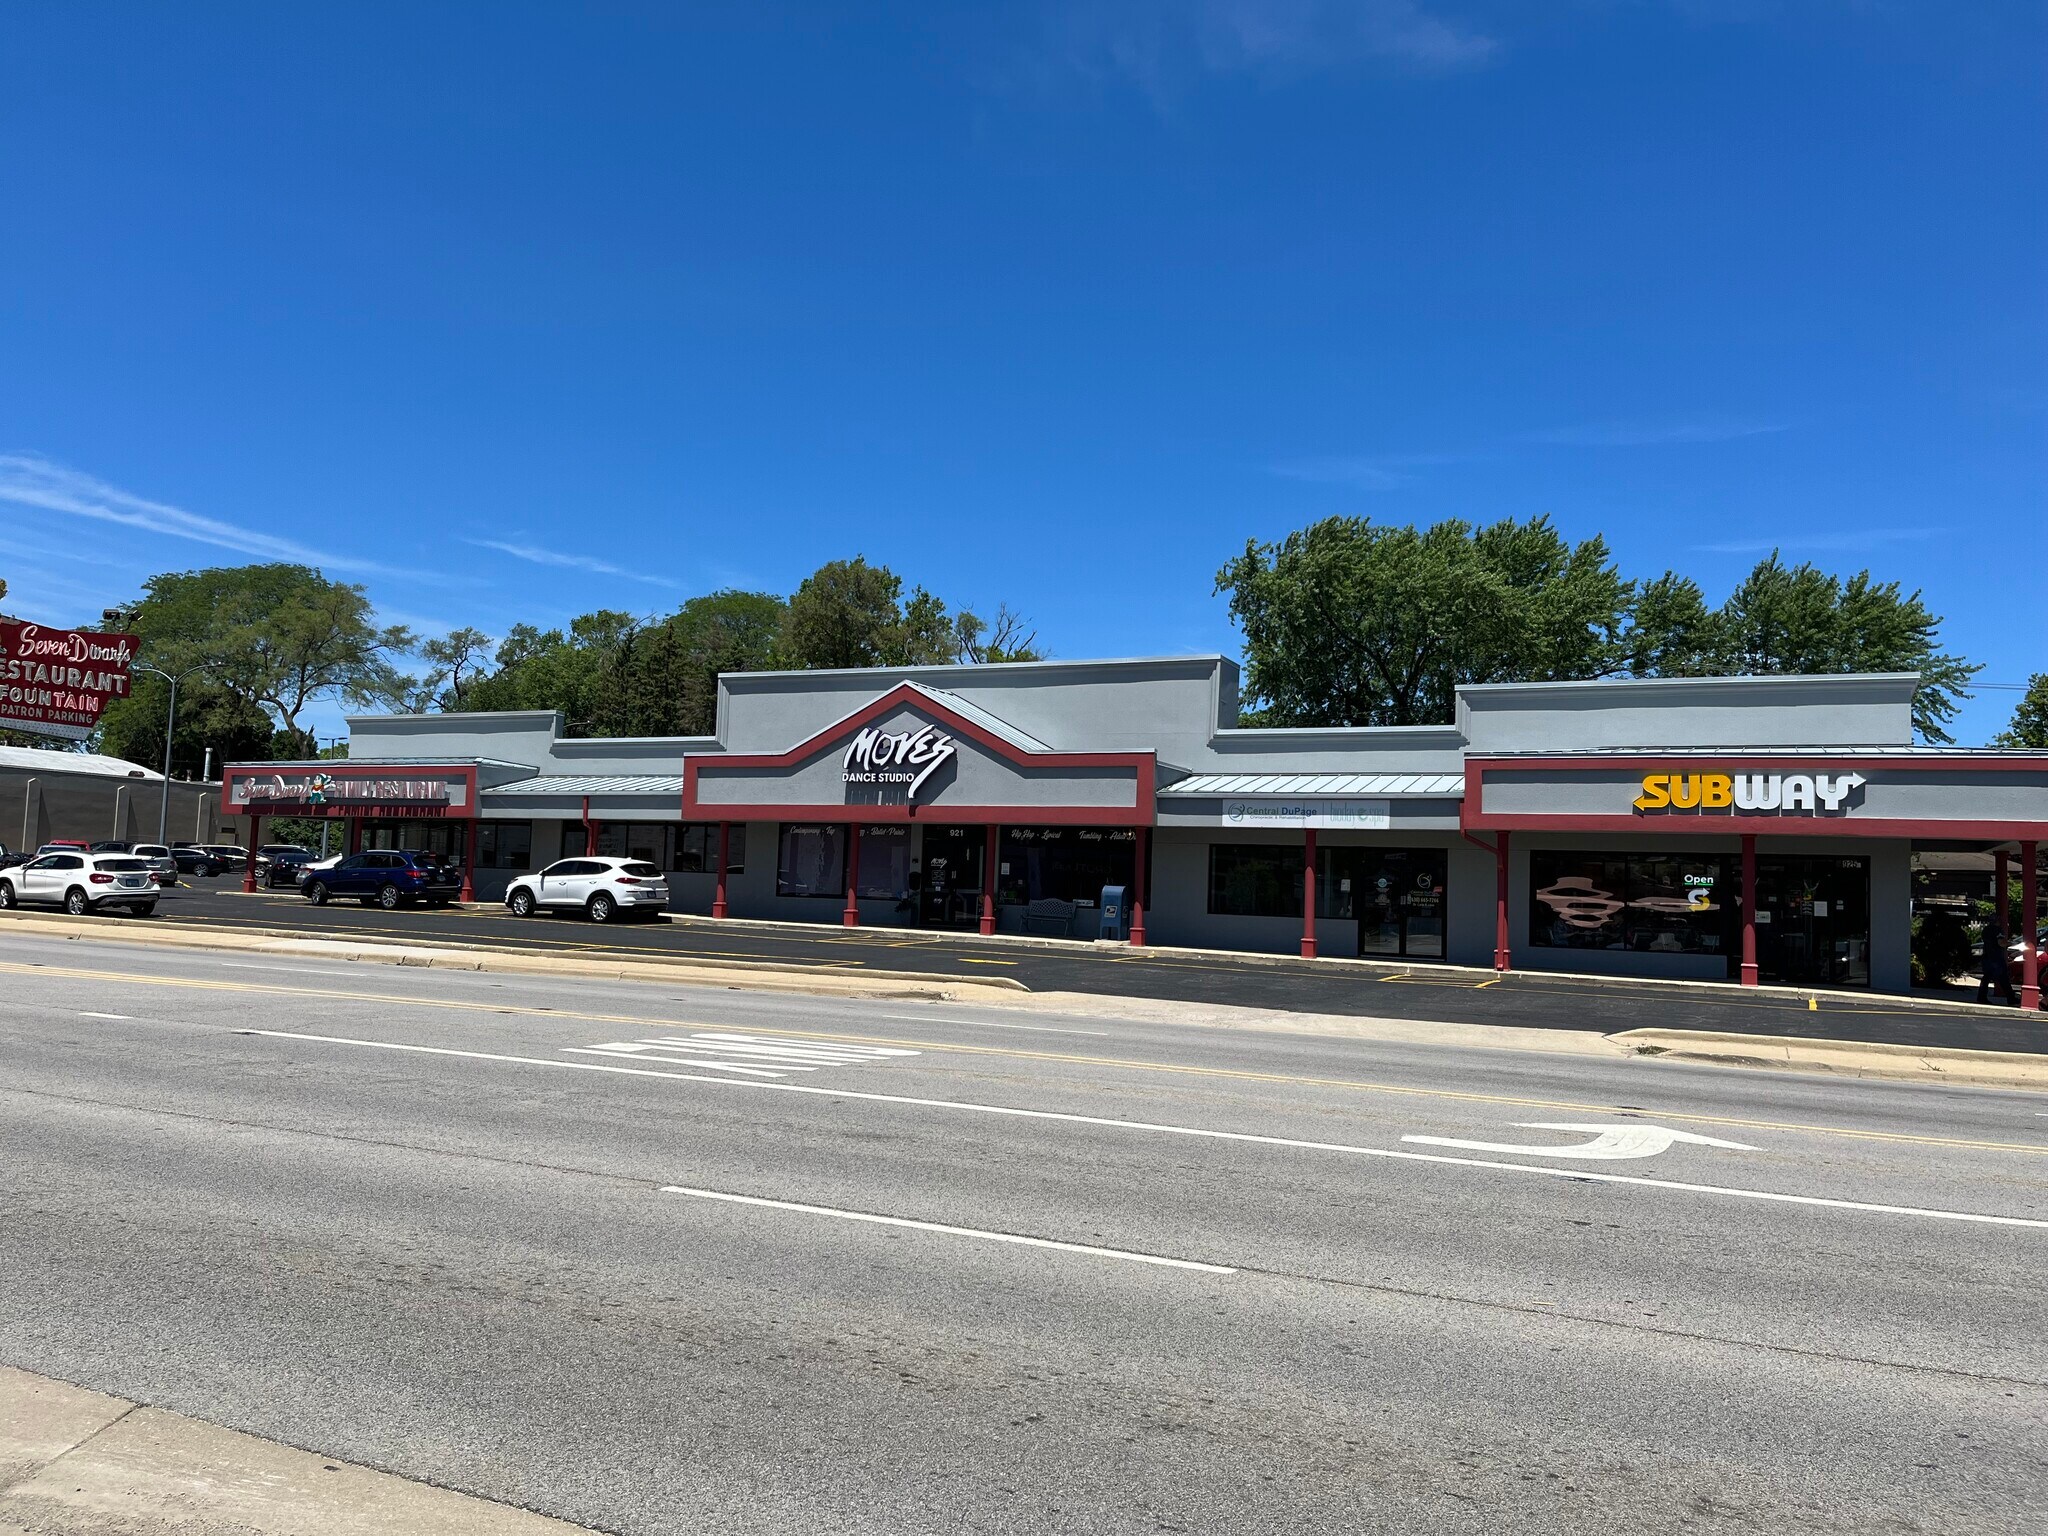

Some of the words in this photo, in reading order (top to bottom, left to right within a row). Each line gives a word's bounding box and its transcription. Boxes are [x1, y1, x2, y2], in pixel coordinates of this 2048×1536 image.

[18, 625, 71, 657] Seven
[67, 633, 131, 668] Dwarfs
[0, 683, 99, 712] FOUNTAIN
[1, 704, 43, 718] PATRON
[48, 710, 93, 724] PARKING
[842, 773, 876, 782] DANCE
[878, 773, 915, 782] STUDIO
[335, 781, 375, 799] FAMILY
[1633, 772, 1866, 811] SUBWAY
[1246, 806, 1279, 815] Central
[1281, 806, 1317, 817] DuPage
[950, 829, 963, 837] 921
[1684, 874, 1714, 886] Open
